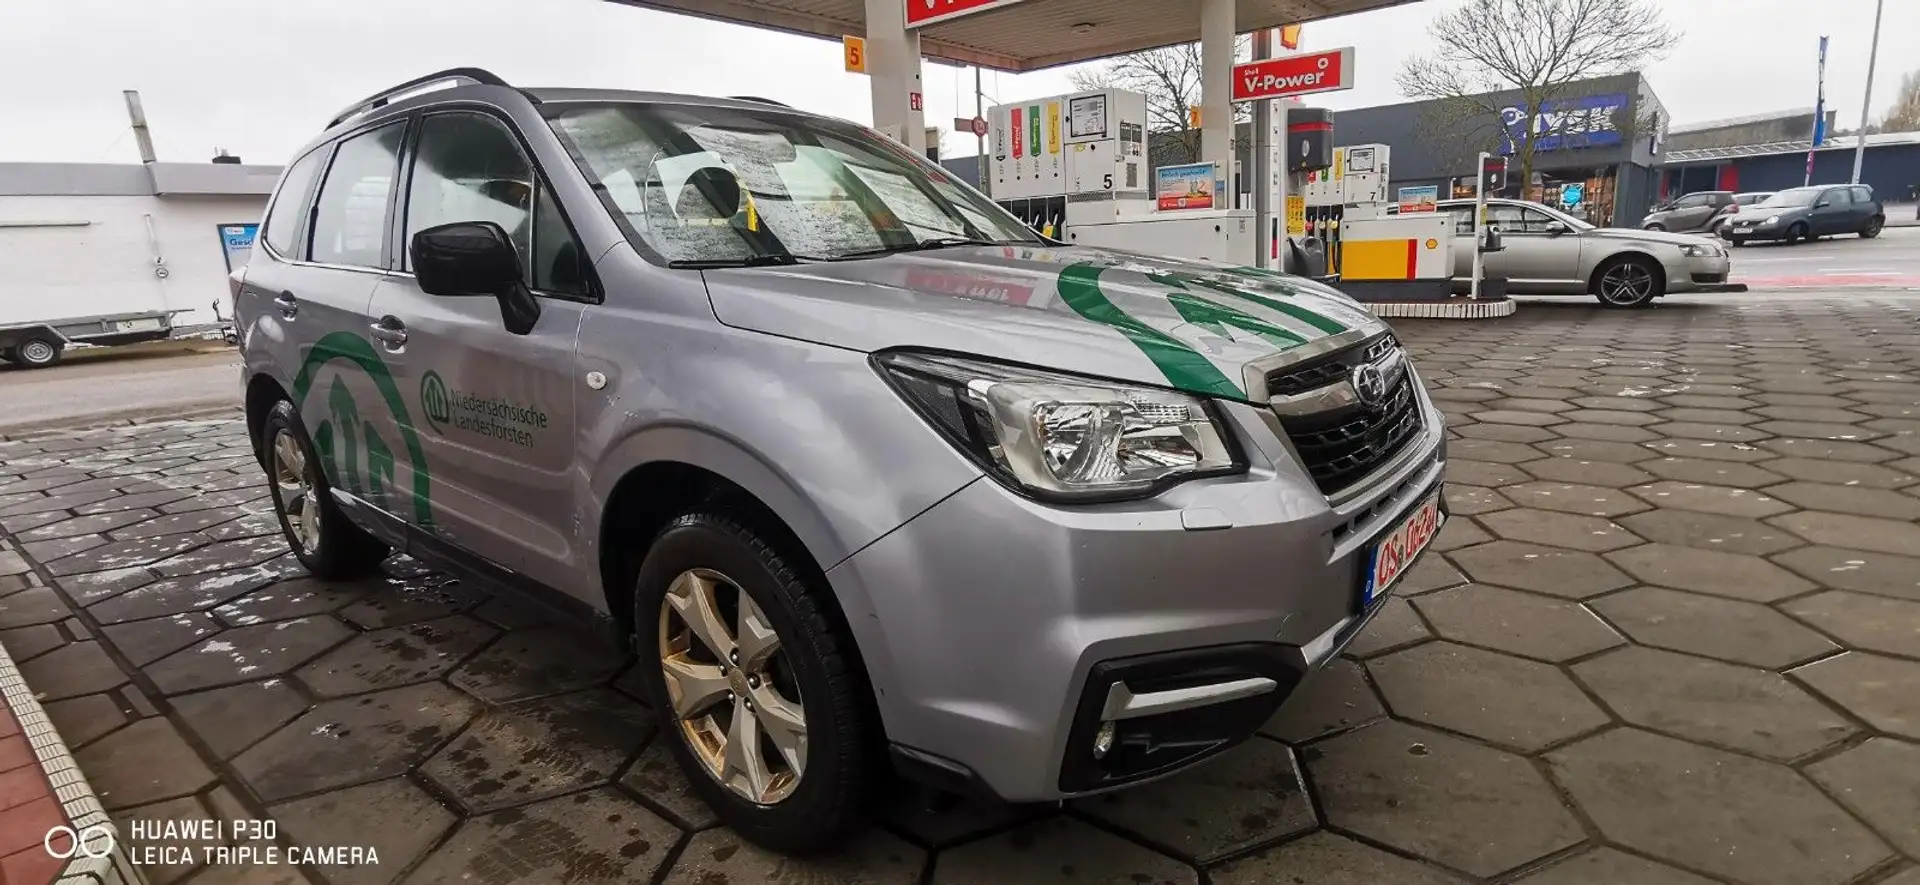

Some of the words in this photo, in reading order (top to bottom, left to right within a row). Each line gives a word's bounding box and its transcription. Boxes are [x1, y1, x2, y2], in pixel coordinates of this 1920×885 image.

[849, 47, 860, 66] 5
[1244, 71, 1325, 93] V-Power
[1103, 173, 1113, 190] 5
[1370, 191, 1377, 200] 7
[450, 387, 548, 429] Niedersächsische
[453, 409, 534, 448] Landesforsten
